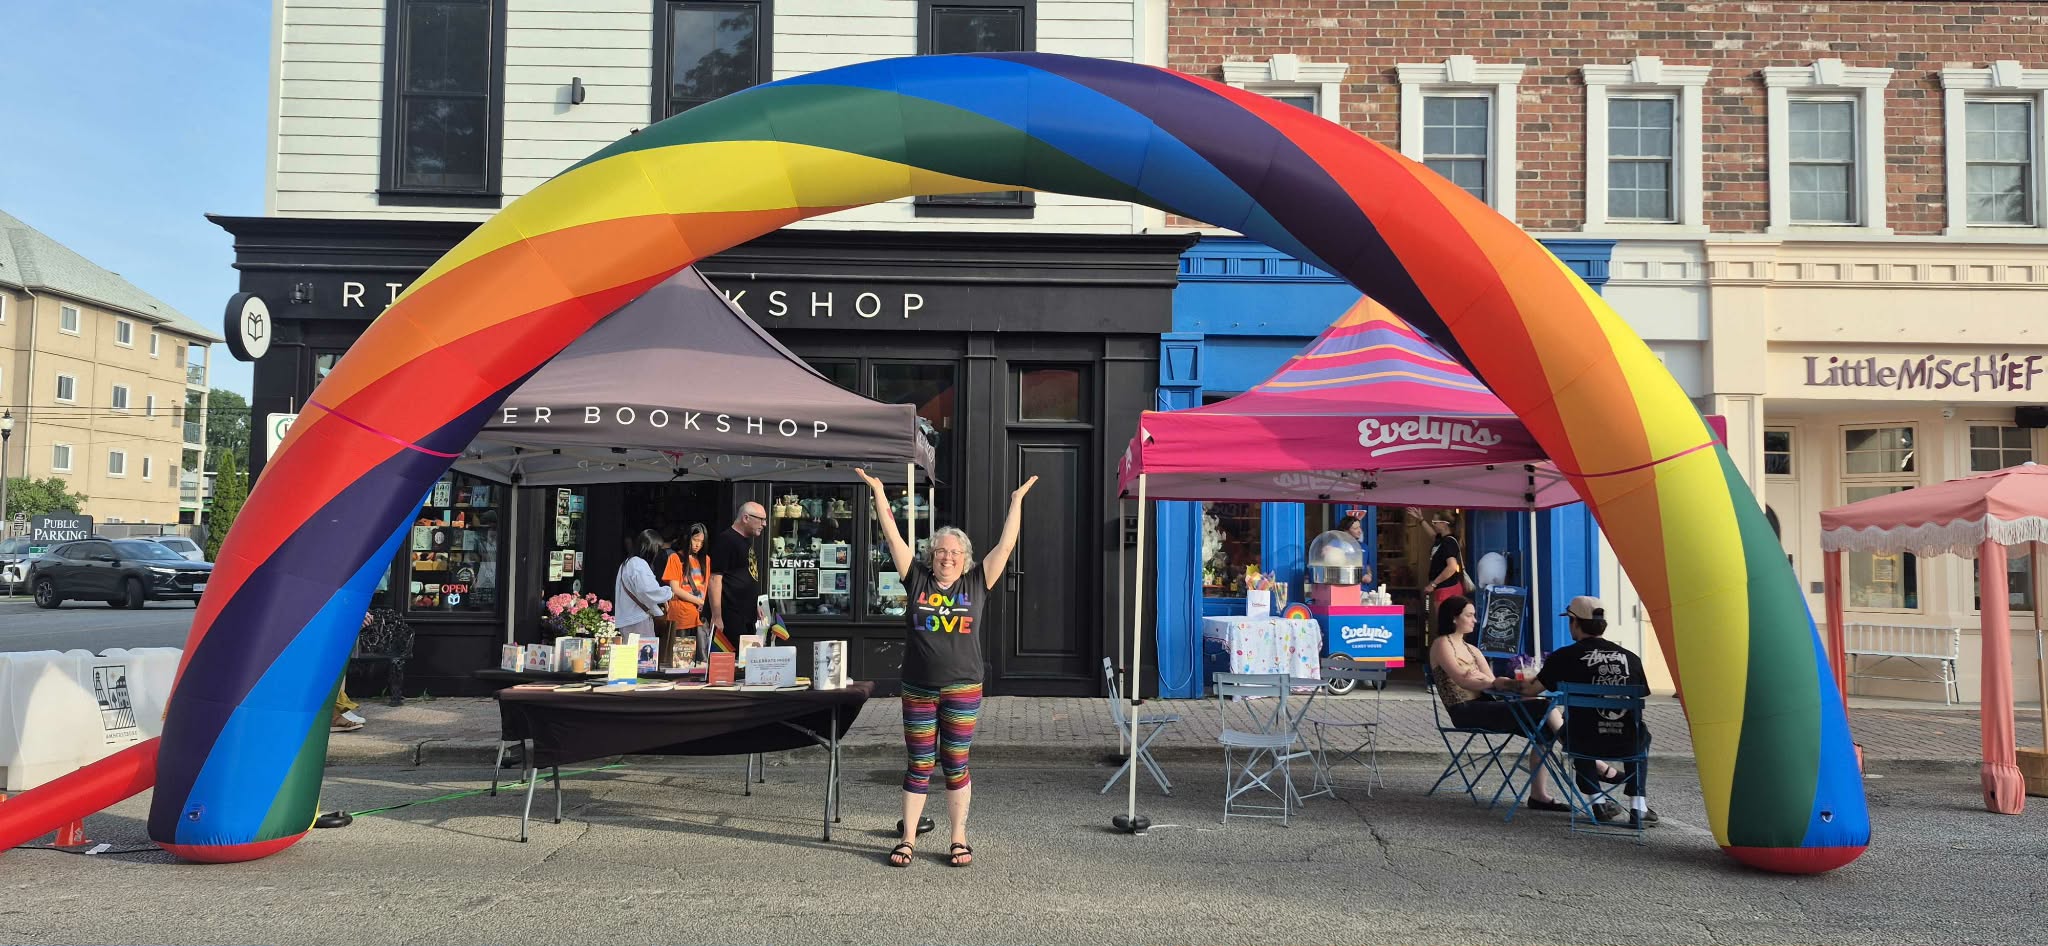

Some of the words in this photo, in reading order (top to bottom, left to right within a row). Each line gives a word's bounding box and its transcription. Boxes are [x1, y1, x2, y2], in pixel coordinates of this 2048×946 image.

[725, 289, 924, 318] KSHOP
[1802, 355, 1896, 386] Little
[584, 406, 828, 438] BOOKSHOP
[1357, 416, 1502, 449] Evelyn's
[43, 518, 79, 529] PUBLIC
[33, 528, 88, 541] PARKING
[772, 558, 815, 568] EVENTS
[441, 584, 468, 593] OPEN
[917, 592, 971, 607] LOVE
[938, 605, 951, 615] is
[912, 613, 974, 634] LOVE
[1341, 624, 1393, 640] Evelyn's
